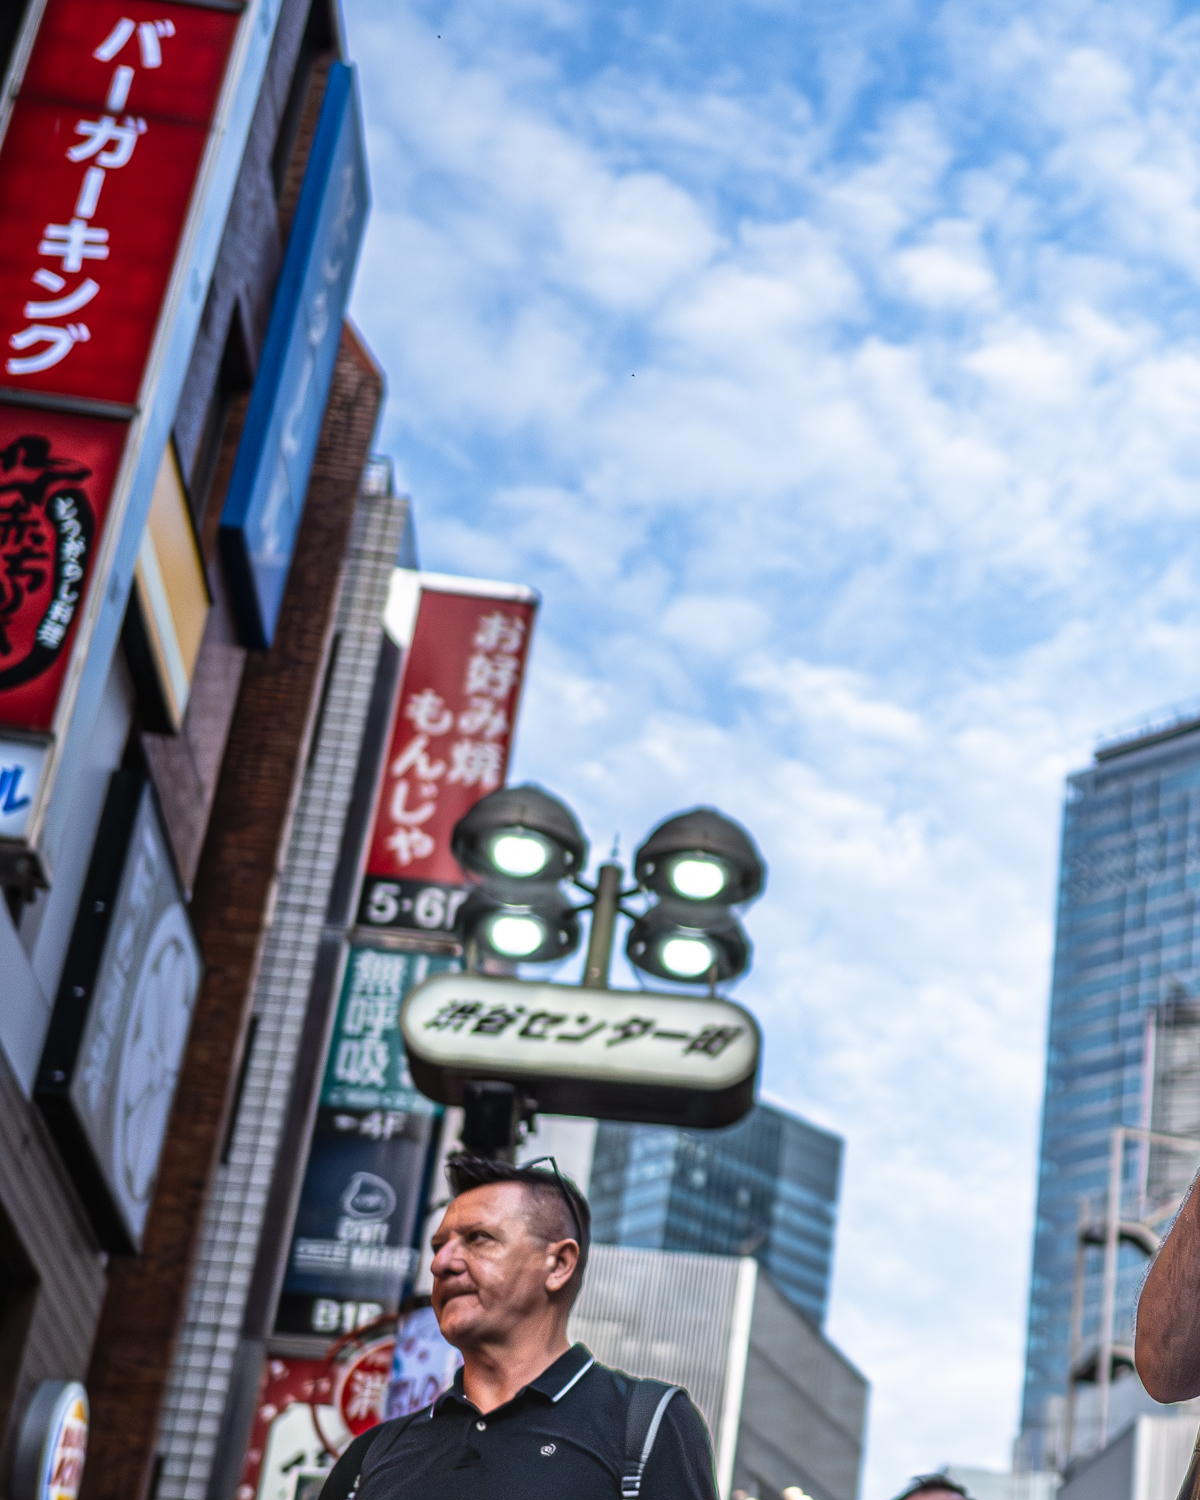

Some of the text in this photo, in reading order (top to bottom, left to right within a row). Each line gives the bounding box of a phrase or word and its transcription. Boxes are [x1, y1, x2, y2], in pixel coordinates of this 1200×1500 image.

[6, 18, 175, 374] バーガーキング
